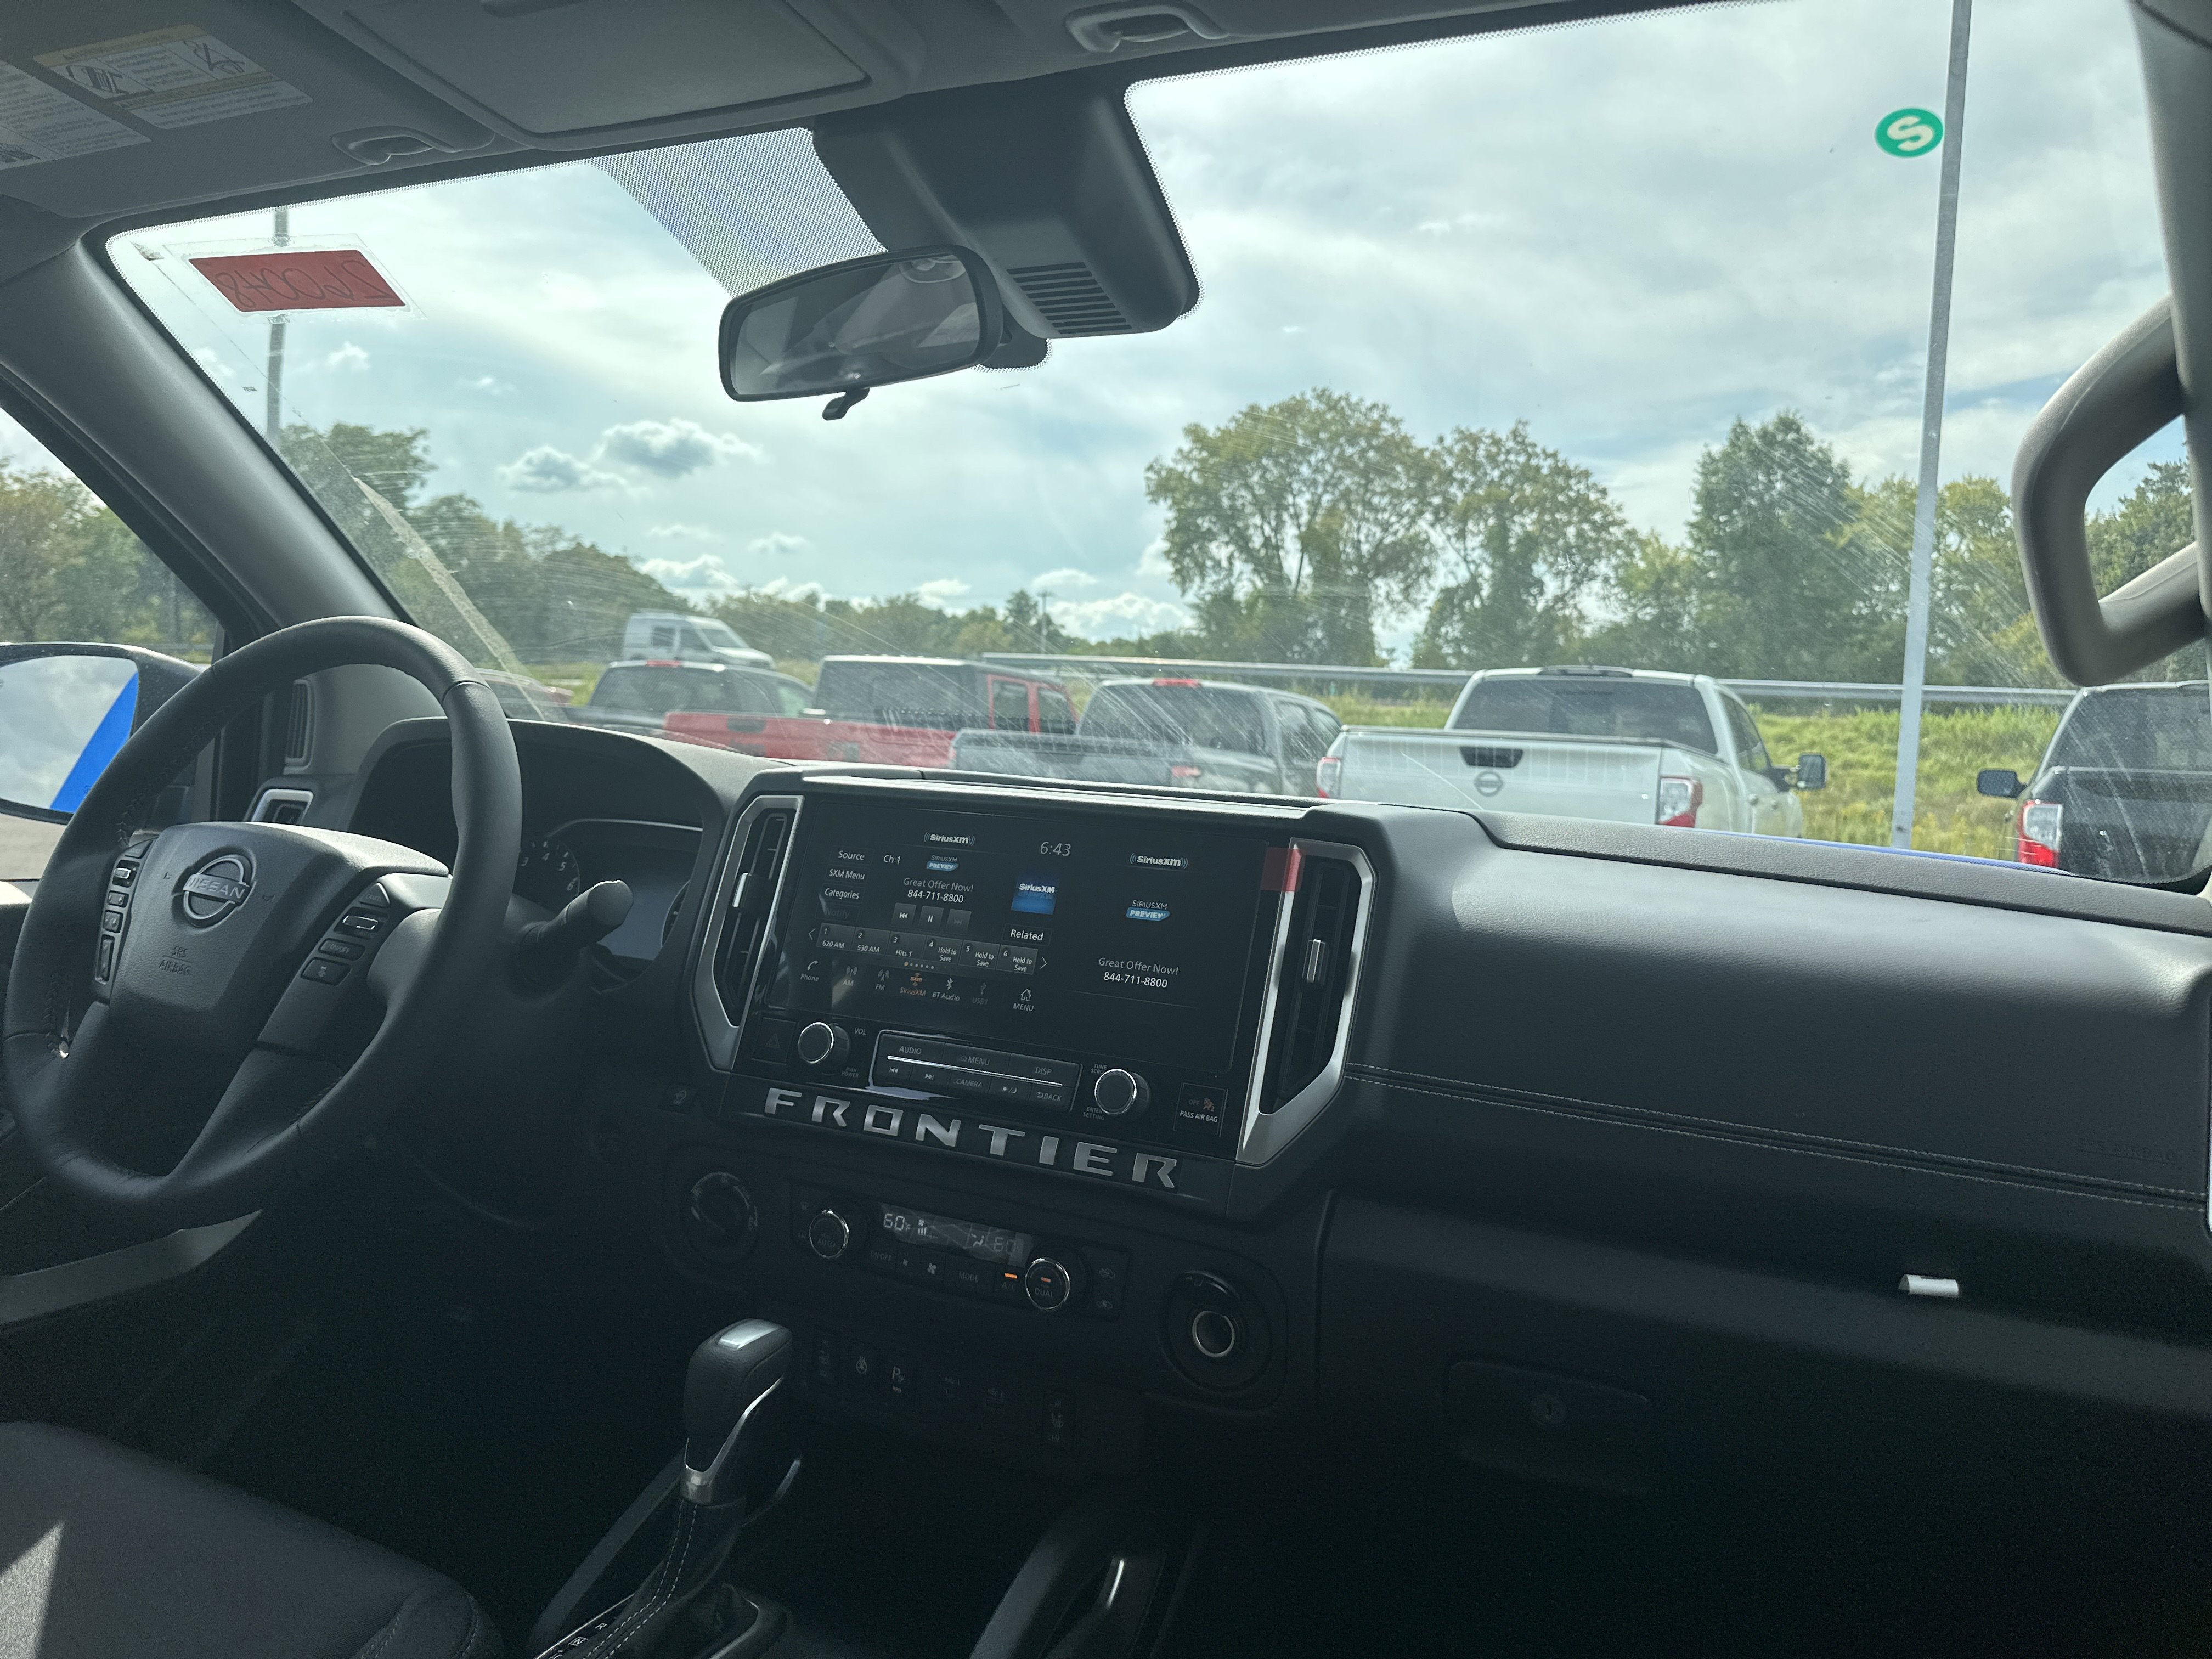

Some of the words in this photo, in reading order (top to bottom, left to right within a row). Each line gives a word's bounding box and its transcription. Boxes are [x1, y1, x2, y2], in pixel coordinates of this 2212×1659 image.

[1887, 115, 1934, 151] S
[1040, 842, 1071, 856] 6:43
[838, 850, 865, 861] Source
[883, 854, 894, 864] Ch
[896, 856, 901, 864] 1
[829, 868, 844, 878] SXM
[845, 870, 865, 880] Menu
[184, 877, 245, 899] NISSAN
[903, 877, 926, 889] Great
[928, 879, 950, 890] Offer
[951, 882, 974, 893] Now!
[825, 888, 860, 900] Categories
[907, 889, 964, 904] 844-711-8800
[1129, 910, 1167, 920] PREVIEW
[1010, 929, 1044, 942] Related
[1098, 957, 1124, 969] Great
[1126, 960, 1152, 972] Offer
[1153, 963, 1179, 975] Now!
[800, 973, 819, 982] Phone
[1103, 972, 1168, 988] 844-711-8800
[941, 992, 960, 1001] Audio
[1013, 1002, 1035, 1012] MENU
[899, 1046, 922, 1055] AUDIO
[967, 1056, 991, 1066] MENU
[1035, 1066, 1052, 1076] DISP
[956, 1079, 983, 1088] CAMERA
[1043, 1092, 1062, 1102] BACK
[1083, 1111, 1105, 1120] SETTING
[1180, 1110, 1194, 1119] PASS
[1206, 1115, 1218, 1123] BAG
[764, 1087, 1177, 1189] FRONTIER
[959, 1271, 979, 1283] MODE
[1034, 1287, 1055, 1299] DUAL
